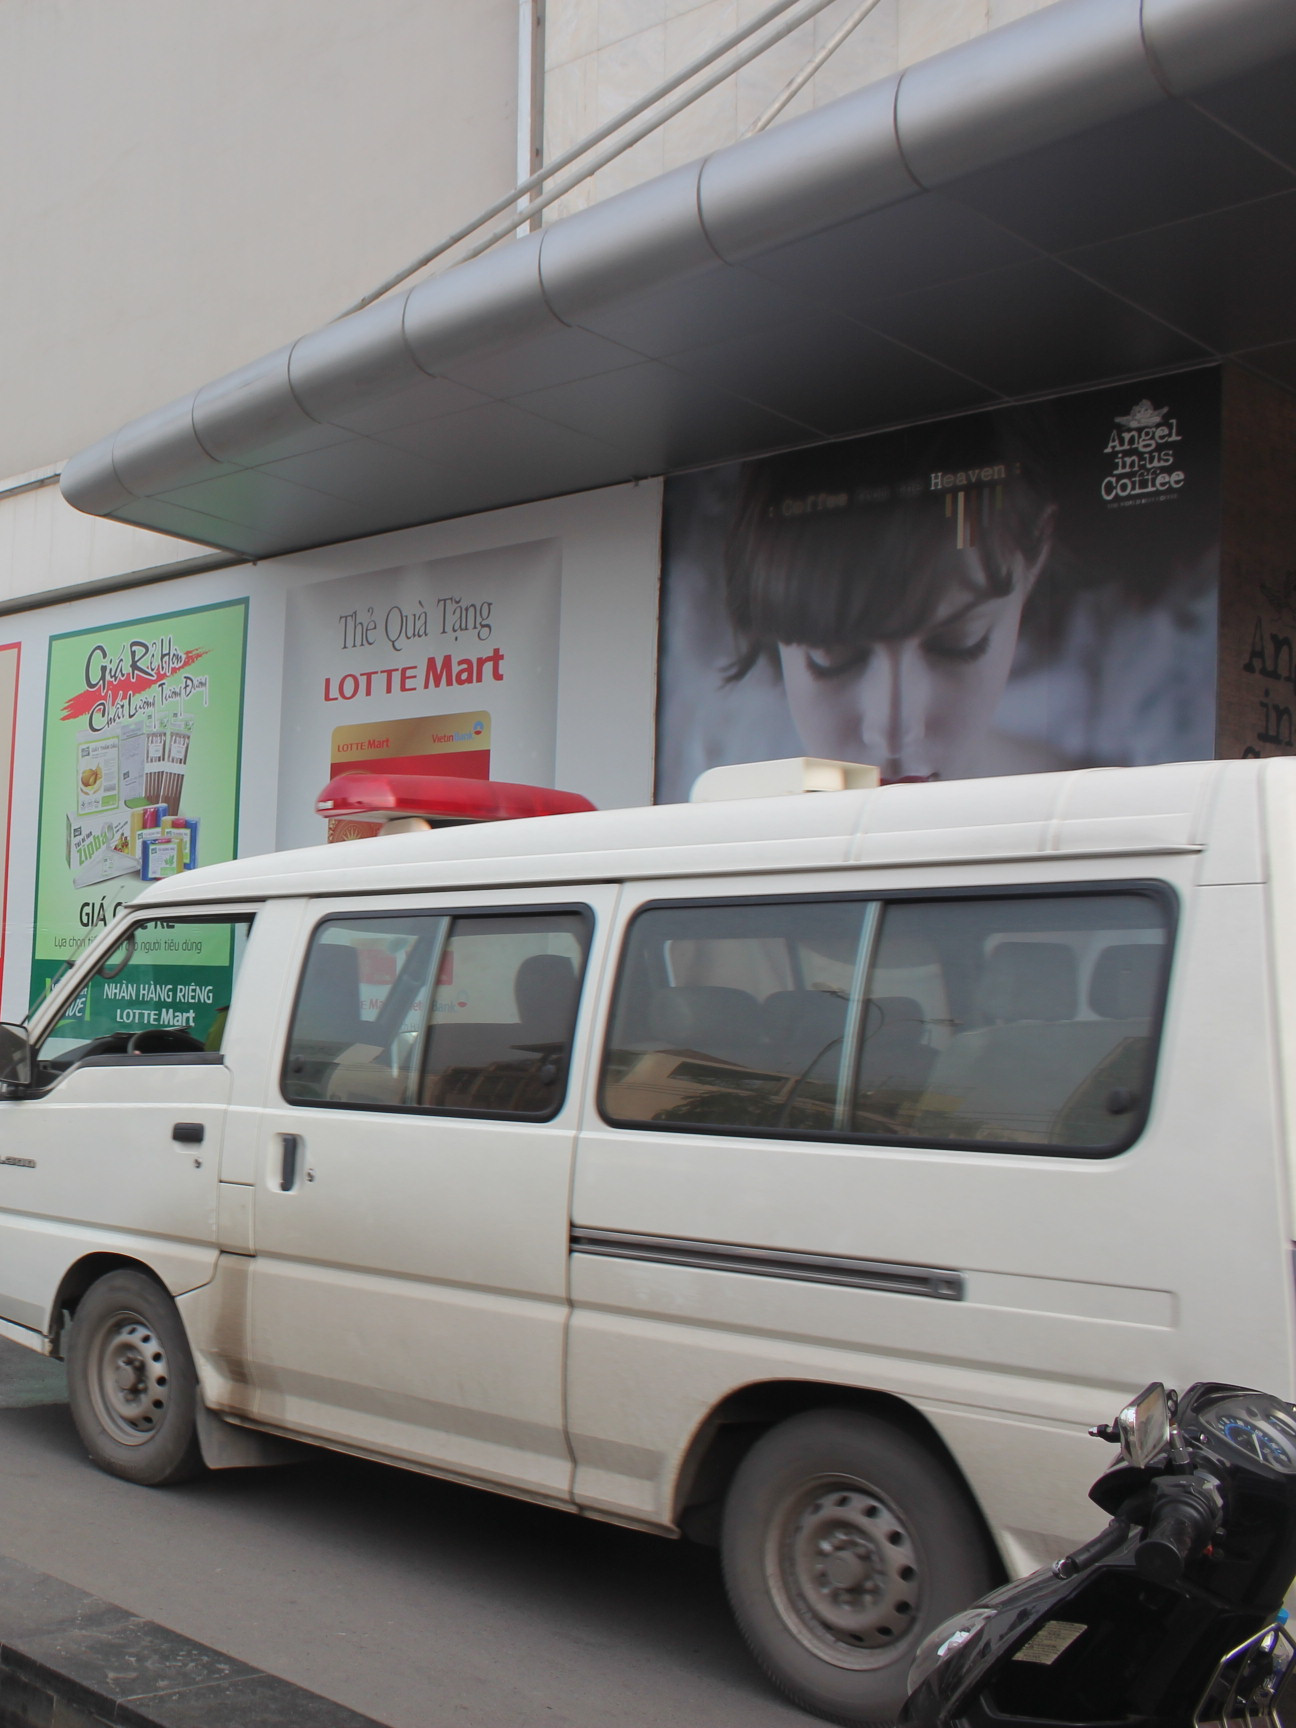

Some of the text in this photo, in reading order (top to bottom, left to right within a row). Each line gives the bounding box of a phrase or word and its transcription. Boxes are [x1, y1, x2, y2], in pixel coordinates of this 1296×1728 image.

[1103, 419, 1182, 453] Angel
[929, 464, 1005, 490] Heaven
[1113, 450, 1174, 474] in-us
[1101, 468, 1185, 500] Coffee
[339, 596, 493, 651] Thẻ Quà Tặng
[85, 643, 126, 694] Giá
[324, 648, 504, 702] LOTTE Mart
[88, 691, 125, 733] Chất
[337, 742, 366, 753] LOTTE
[367, 738, 390, 749] Mart
[79, 895, 107, 928] GIÁ
[54, 936, 67, 949] Lựa
[69, 936, 86, 949] chọn
[164, 938, 179, 951] tiêu
[139, 980, 173, 1002] HÀNG
[177, 982, 214, 1003] RIÊNG
[116, 1008, 195, 1027] LOTTE Mart
